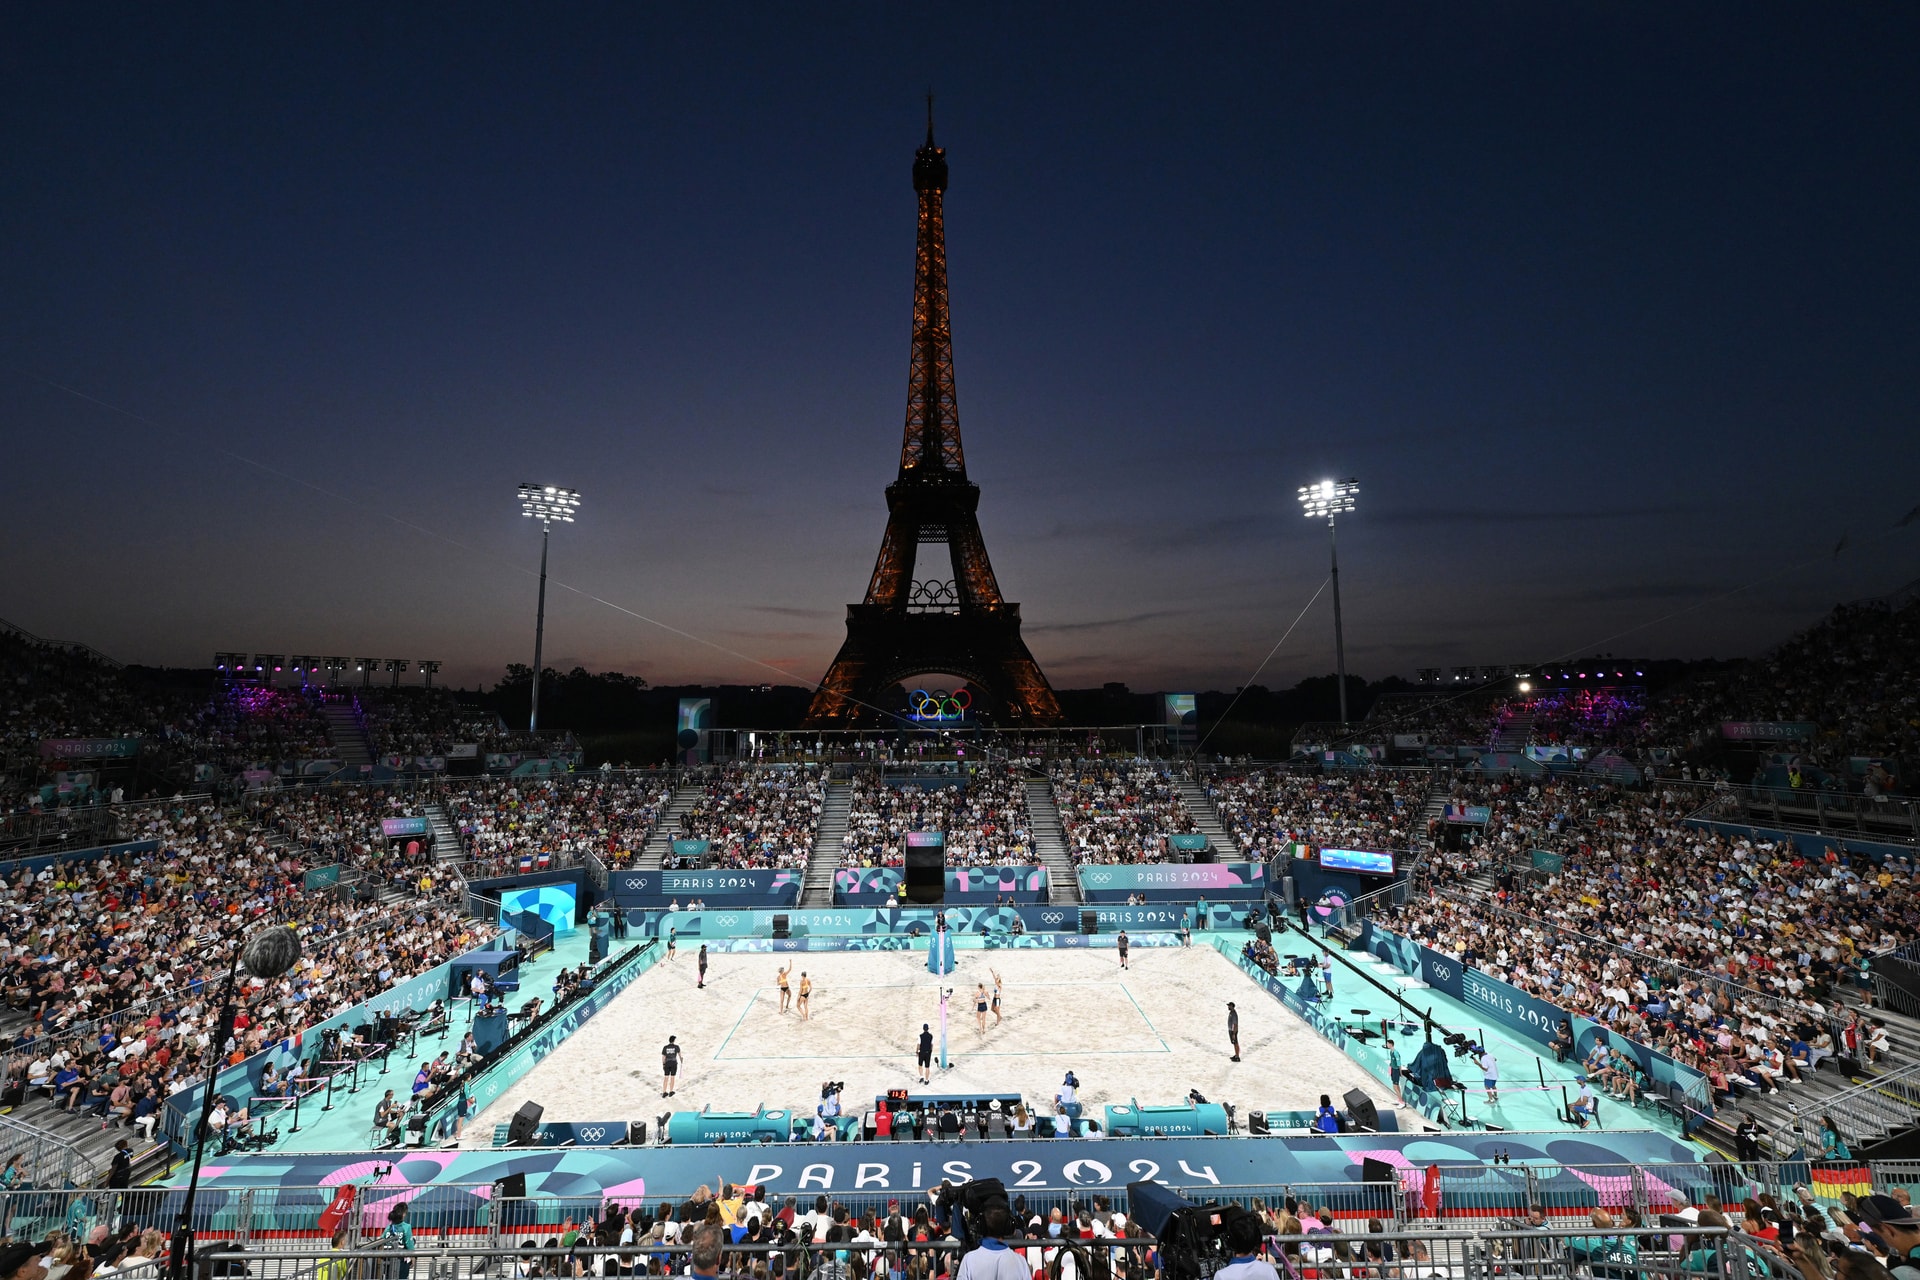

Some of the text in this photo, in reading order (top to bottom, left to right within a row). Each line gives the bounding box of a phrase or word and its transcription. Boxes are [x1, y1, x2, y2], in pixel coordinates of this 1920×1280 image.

[96, 743, 126, 753] 2024
[1182, 872, 1218, 882] 2024
[719, 878, 756, 888] 2024
[813, 915, 851, 926] 2024
[1137, 911, 1175, 922] 2024
[1170, 1124, 1192, 1132] 2024
[730, 1131, 752, 1139] 2024
[1011, 1159, 1221, 1187] 2024
